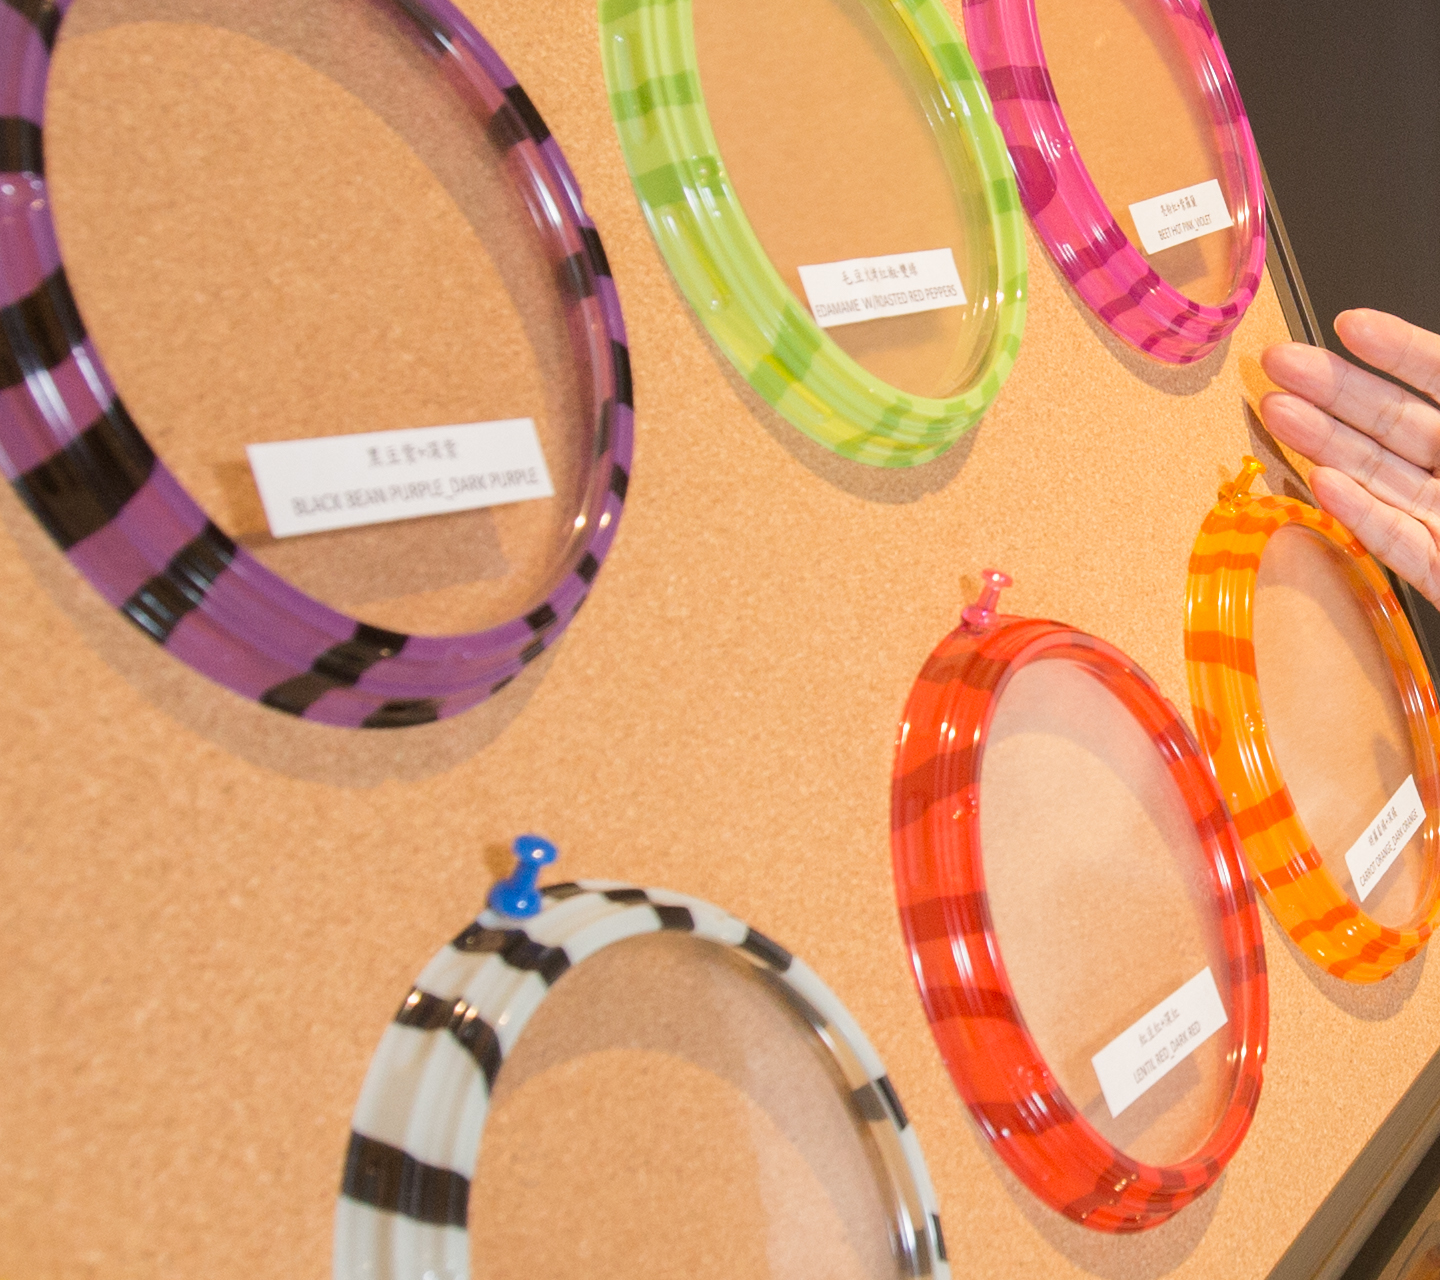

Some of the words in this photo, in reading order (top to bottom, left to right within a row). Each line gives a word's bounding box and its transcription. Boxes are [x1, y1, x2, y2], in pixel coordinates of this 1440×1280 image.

[1157, 226, 1172, 241] BEET
[1170, 222, 1183, 236] HOT
[814, 298, 862, 319] EDAMAME
[907, 288, 925, 303] RED
[924, 284, 958, 300] PEPPERS
[290, 493, 344, 518] BLACK
[343, 487, 389, 509] BEAN
[487, 466, 539, 489] PURPLE
[1359, 860, 1377, 888] CARROT
[1133, 1058, 1157, 1085] LENTIL
[1187, 1020, 1202, 1039] RED
